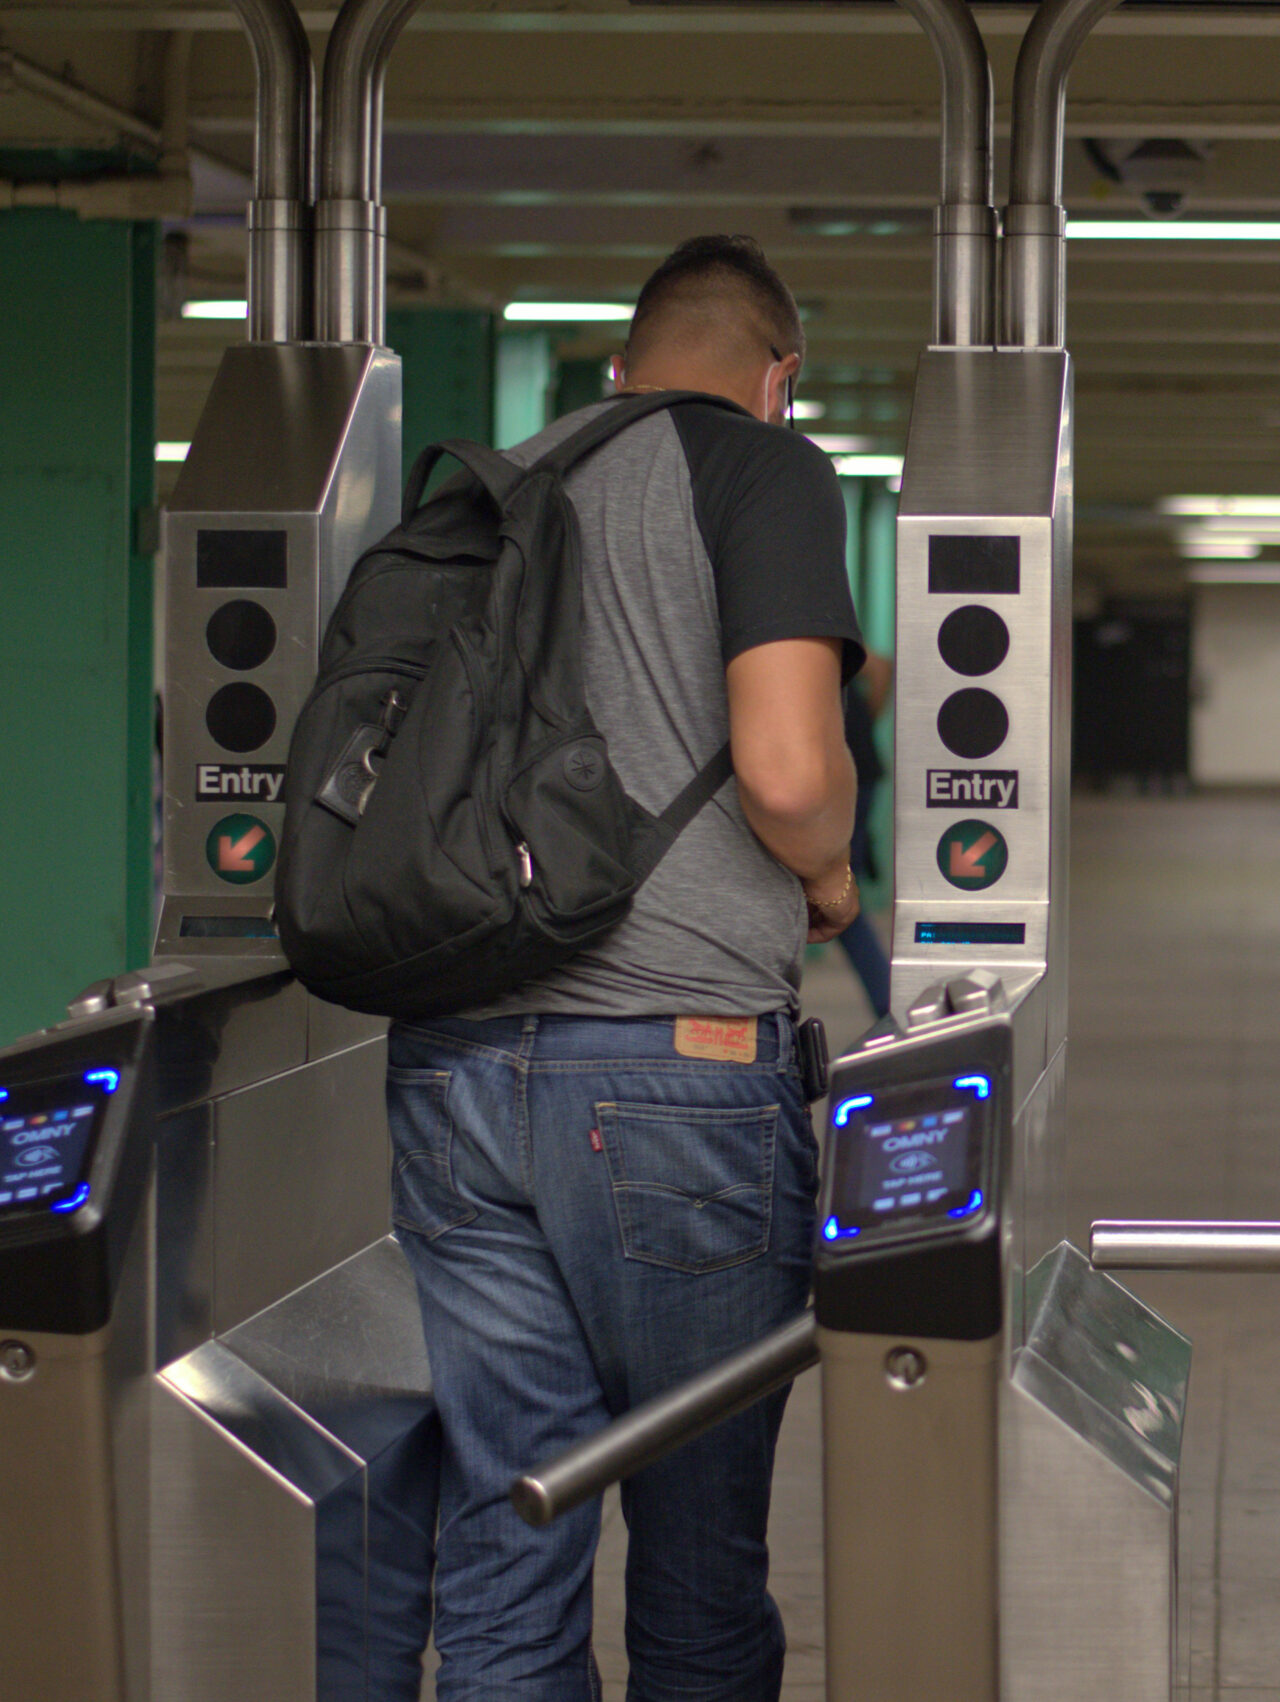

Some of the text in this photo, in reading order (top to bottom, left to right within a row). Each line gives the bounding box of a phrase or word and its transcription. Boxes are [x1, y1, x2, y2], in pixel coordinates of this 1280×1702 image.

[199, 765, 284, 801] Entry
[930, 772, 1015, 807] Entry
[12, 1122, 77, 1145] OMNY
[882, 1128, 948, 1151] OMNY
